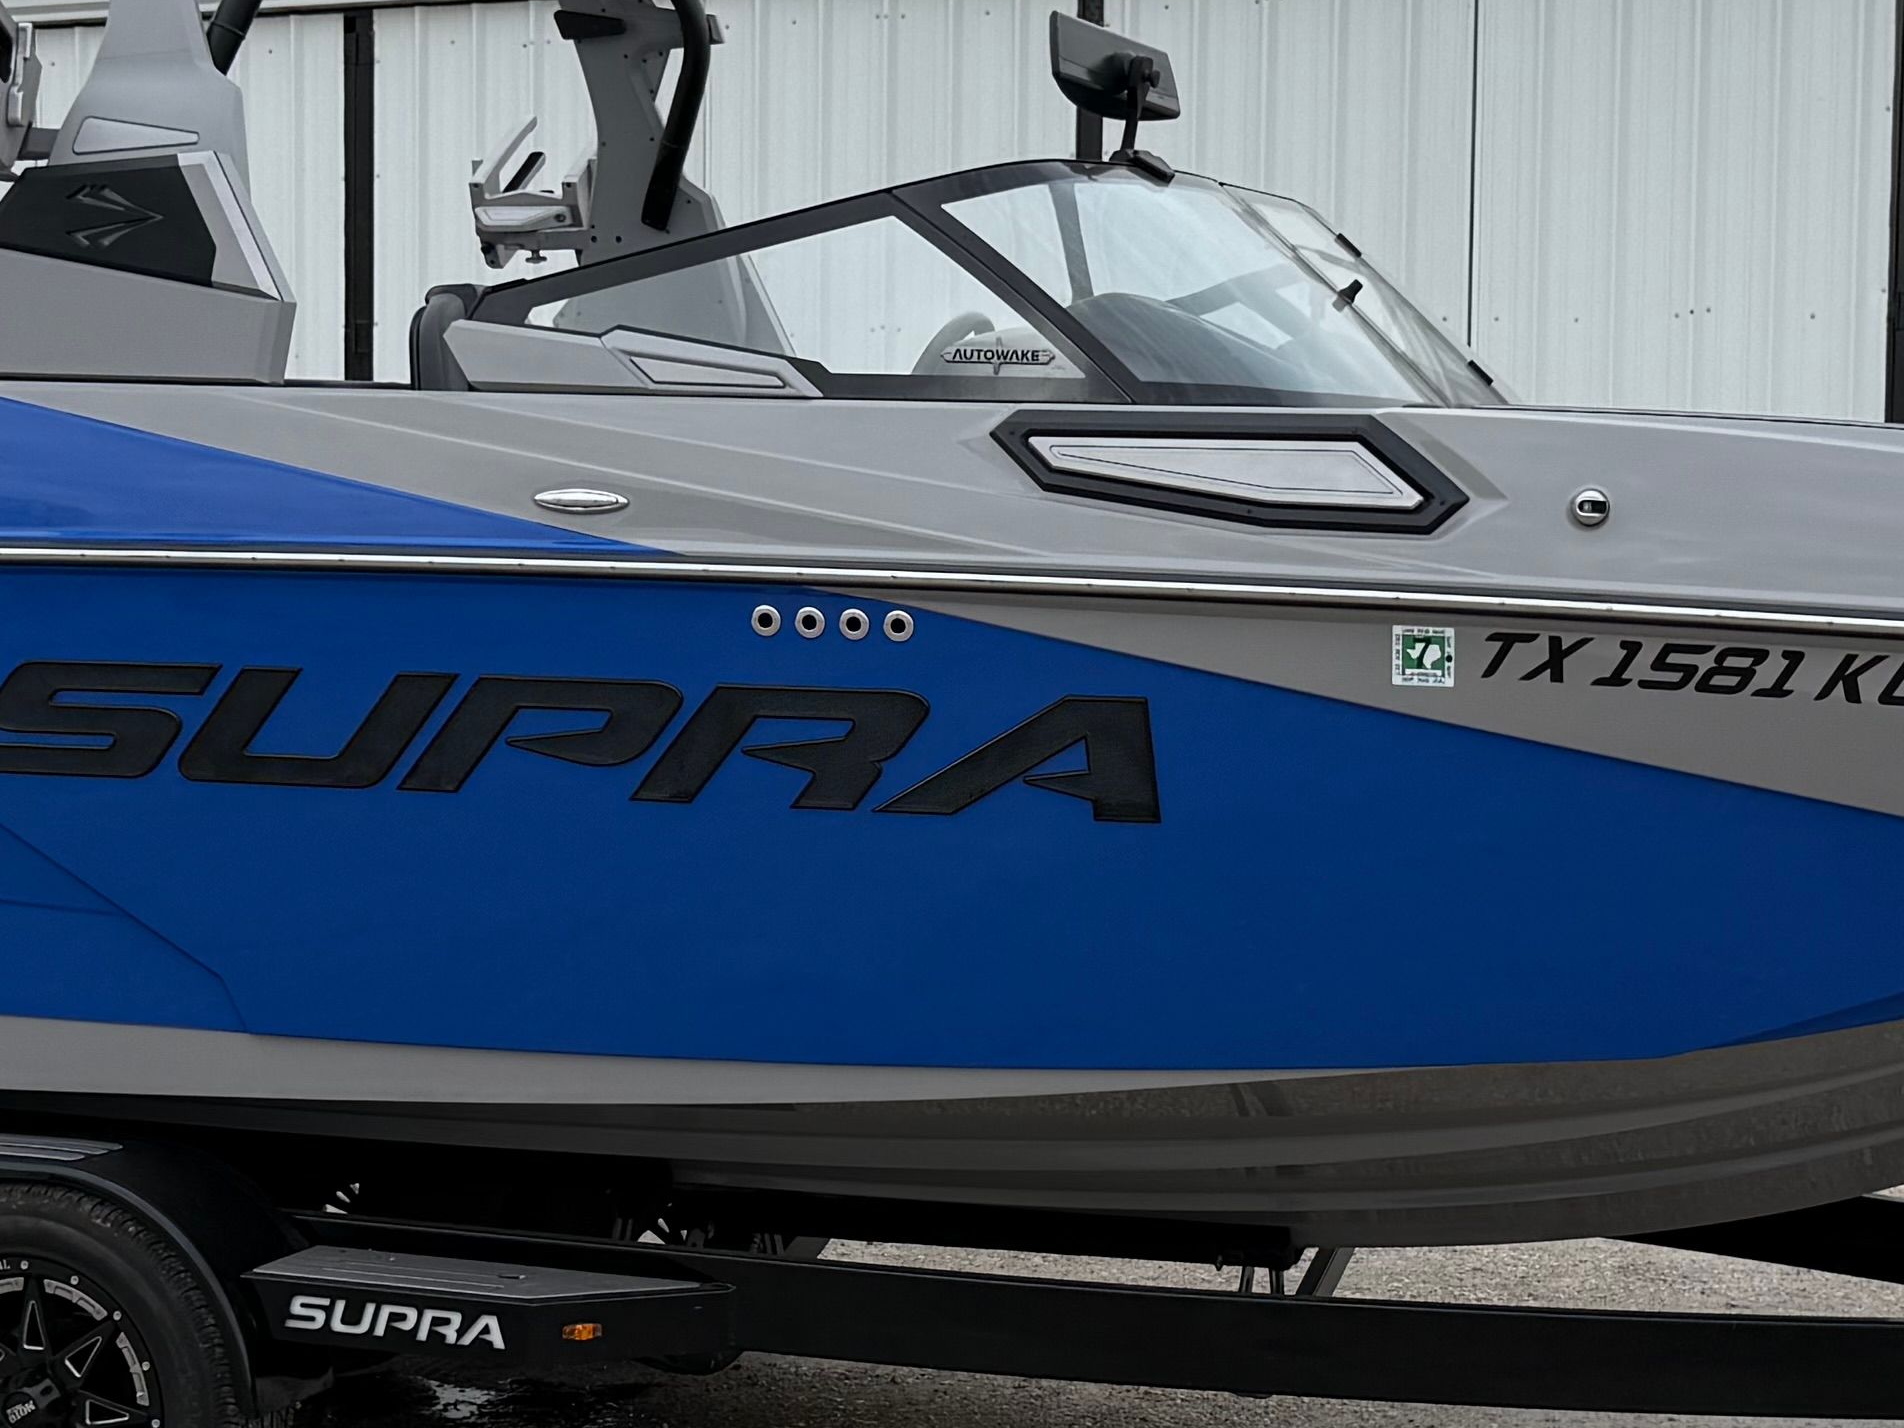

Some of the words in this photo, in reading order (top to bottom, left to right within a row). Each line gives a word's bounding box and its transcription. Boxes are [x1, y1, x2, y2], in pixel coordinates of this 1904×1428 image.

[952, 348, 1040, 362] AUTOWAKE
[1480, 632, 1595, 684] TX
[1589, 639, 1807, 699] 1581
[283, 1294, 507, 1350] SUPRA
